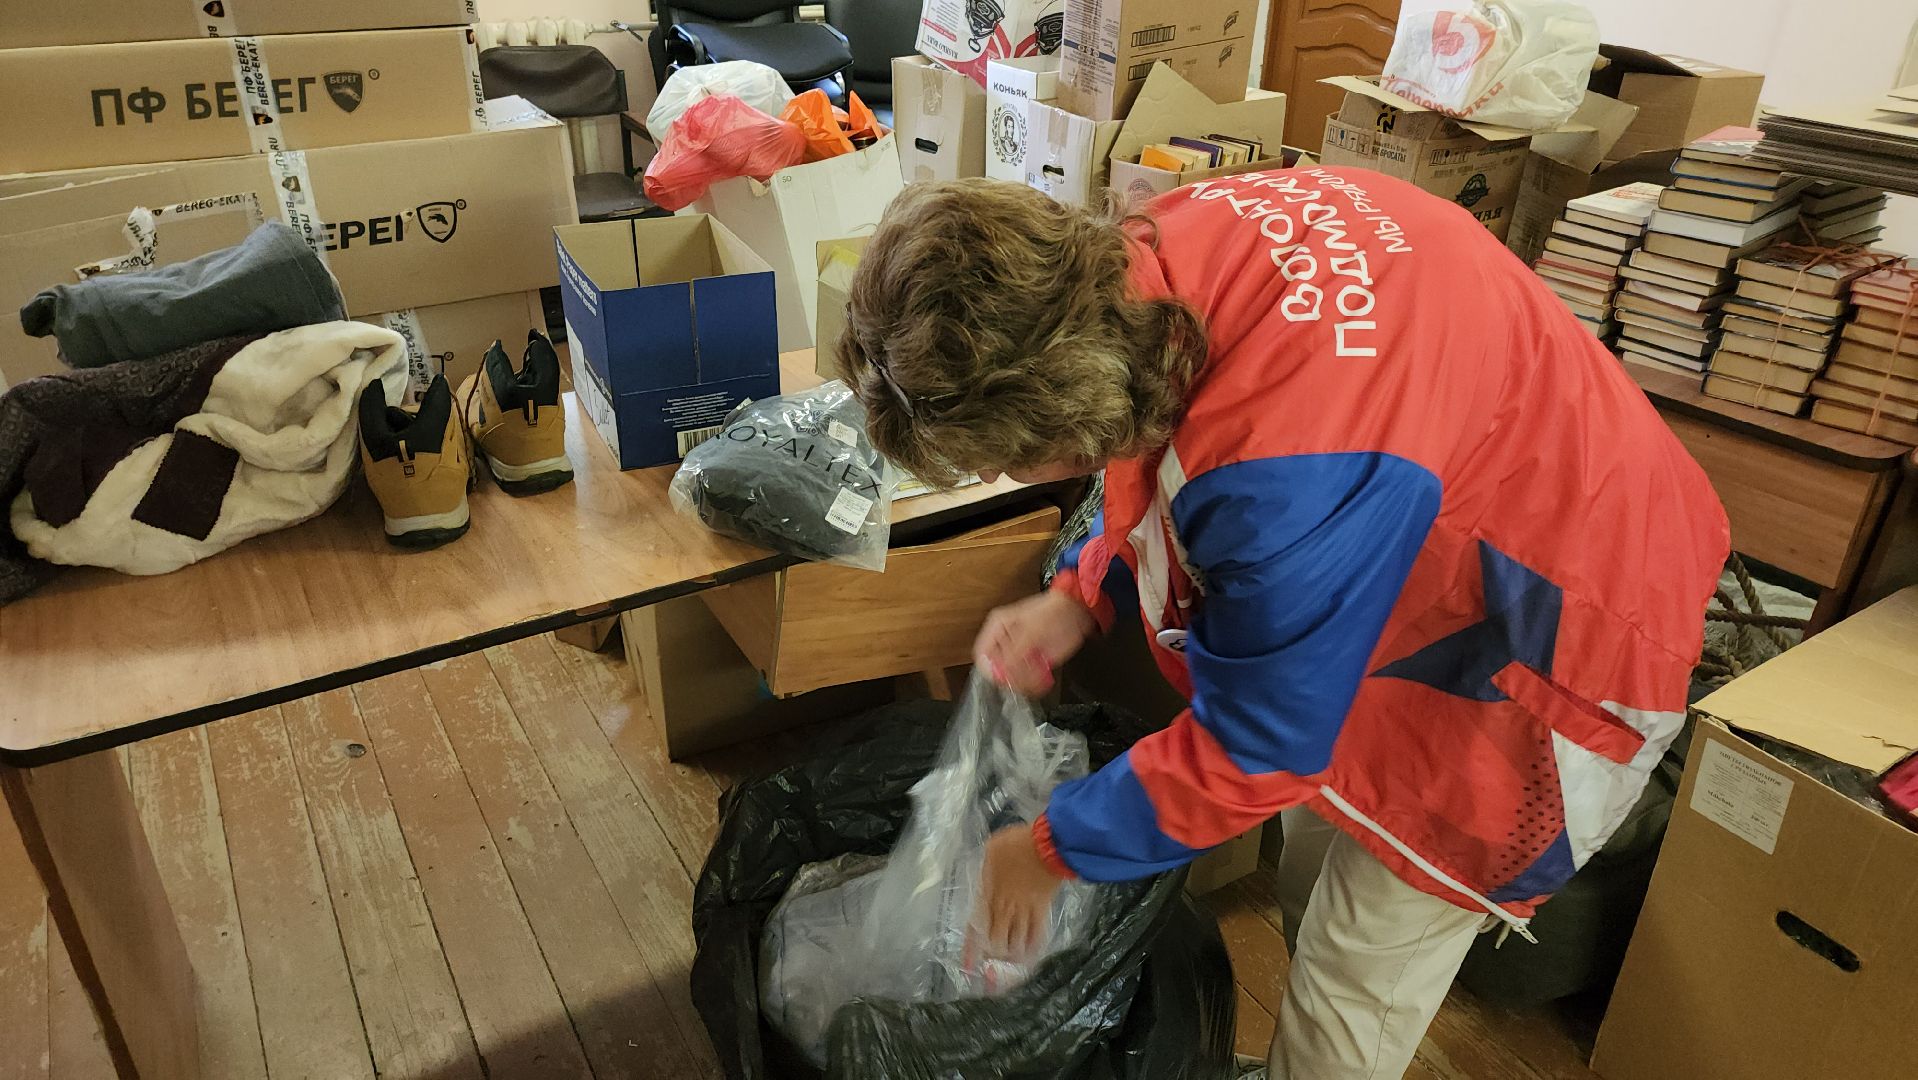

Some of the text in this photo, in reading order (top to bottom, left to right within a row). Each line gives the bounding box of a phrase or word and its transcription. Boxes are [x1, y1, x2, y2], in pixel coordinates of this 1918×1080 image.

[329, 74, 359, 85] БЕРЕГ
[993, 81, 1028, 100] КОНЬЯК
[91, 76, 317, 127] ПФ БЕЕГ
[1365, 216, 1413, 253] МЫ
